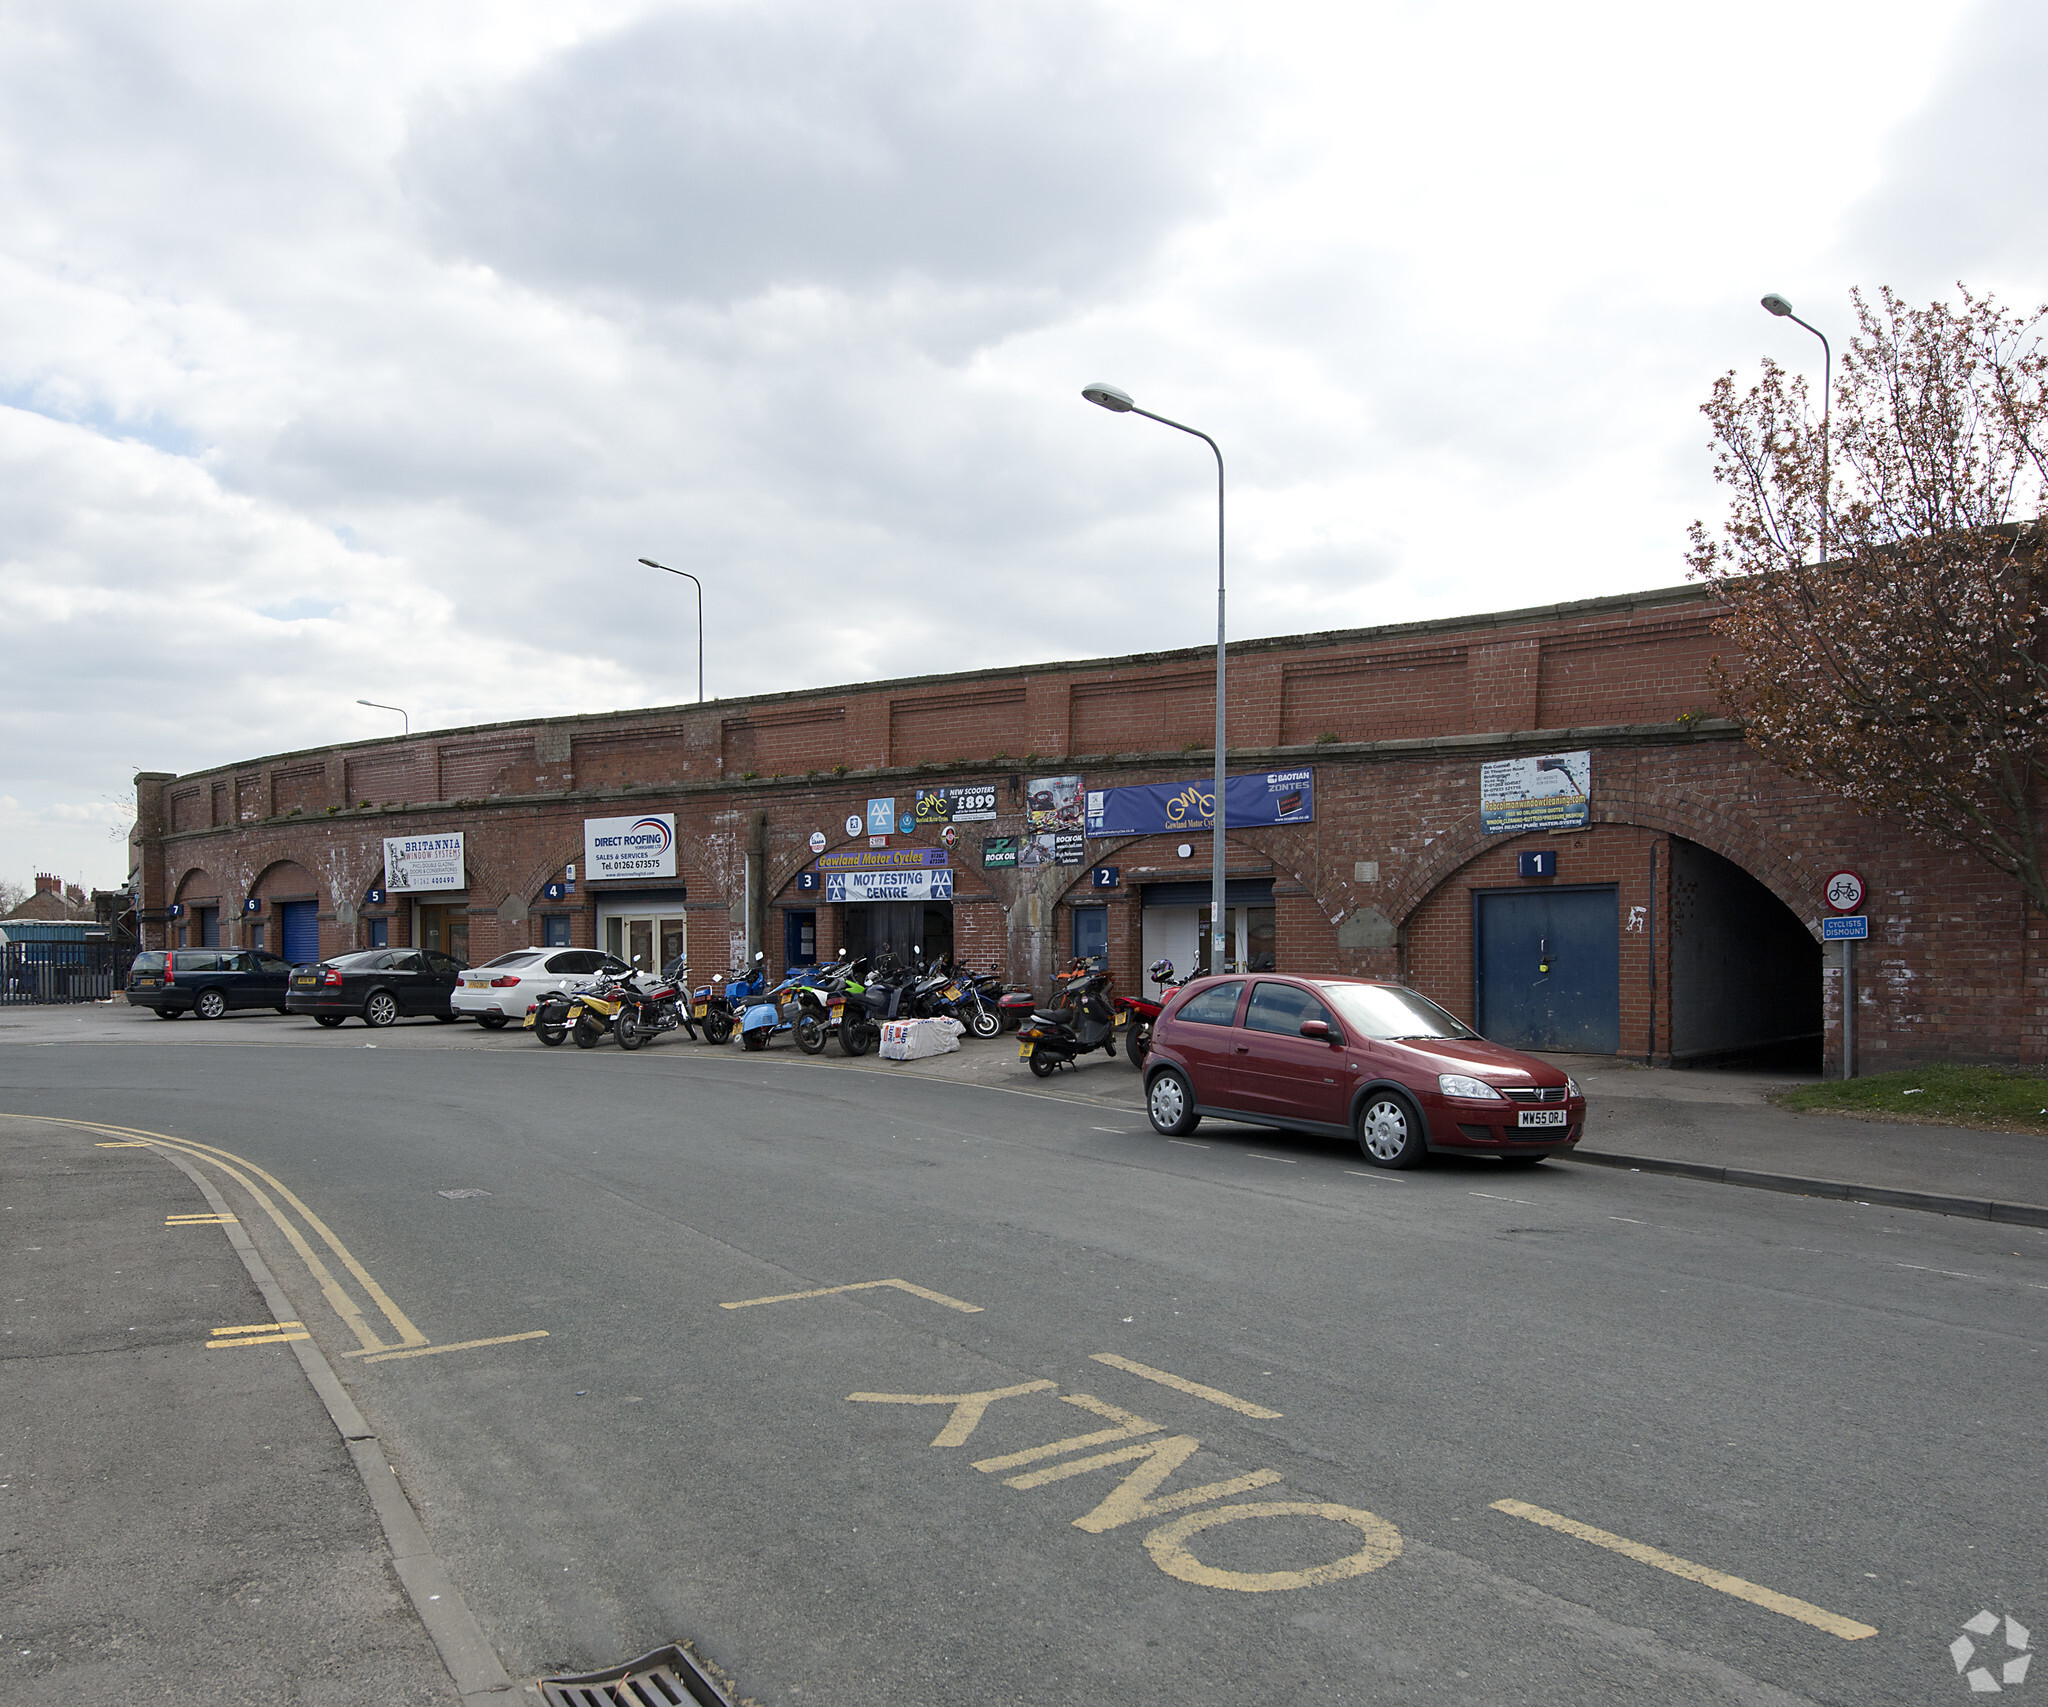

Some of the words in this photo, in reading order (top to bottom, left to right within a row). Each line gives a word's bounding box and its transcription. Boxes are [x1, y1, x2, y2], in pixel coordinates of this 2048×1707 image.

[1278, 772, 1309, 782] BAOTIAN
[950, 788, 964, 796] NEW
[964, 786, 995, 795] SCOOTERS
[1268, 781, 1310, 792] ZONTES
[957, 794, 995, 810] £899
[1485, 794, 1586, 812] Robcolmanwindowcleaning.com
[1165, 820, 1187, 830] Gowland
[1188, 819, 1202, 828] Motor
[1204, 818, 1215, 828] Cycl
[405, 839, 460, 852] BRITANNIA
[594, 836, 622, 848] DIRECT
[624, 834, 661, 846] ROOFING
[405, 851, 432, 860] WINDOW
[434, 849, 460, 858] SYSTEMS
[818, 854, 859, 867] Gowland
[861, 853, 890, 865] Motor
[893, 850, 923, 865] Cycles
[985, 853, 1004, 862] ROCK
[1004, 852, 1016, 860] OIL
[602, 862, 612, 870] Tel.
[614, 861, 634, 869] 01262
[636, 860, 660, 868] 673575
[1533, 854, 1542, 873] 1
[804, 874, 812, 887] 3
[853, 874, 875, 886] MOT
[878, 871, 923, 885] TESTING
[1101, 869, 1110, 884] 2
[372, 891, 379, 901] 5
[550, 885, 558, 896] 4
[866, 887, 908, 899] CENTRE
[173, 905, 179, 914] 7
[248, 900, 255, 909] 6
[1828, 920, 1862, 928] CYCLISTS
[1826, 928, 1864, 936] DISMOUNT
[1522, 1112, 1547, 1125] MW55
[843, 1378, 1404, 1593] ONLY
